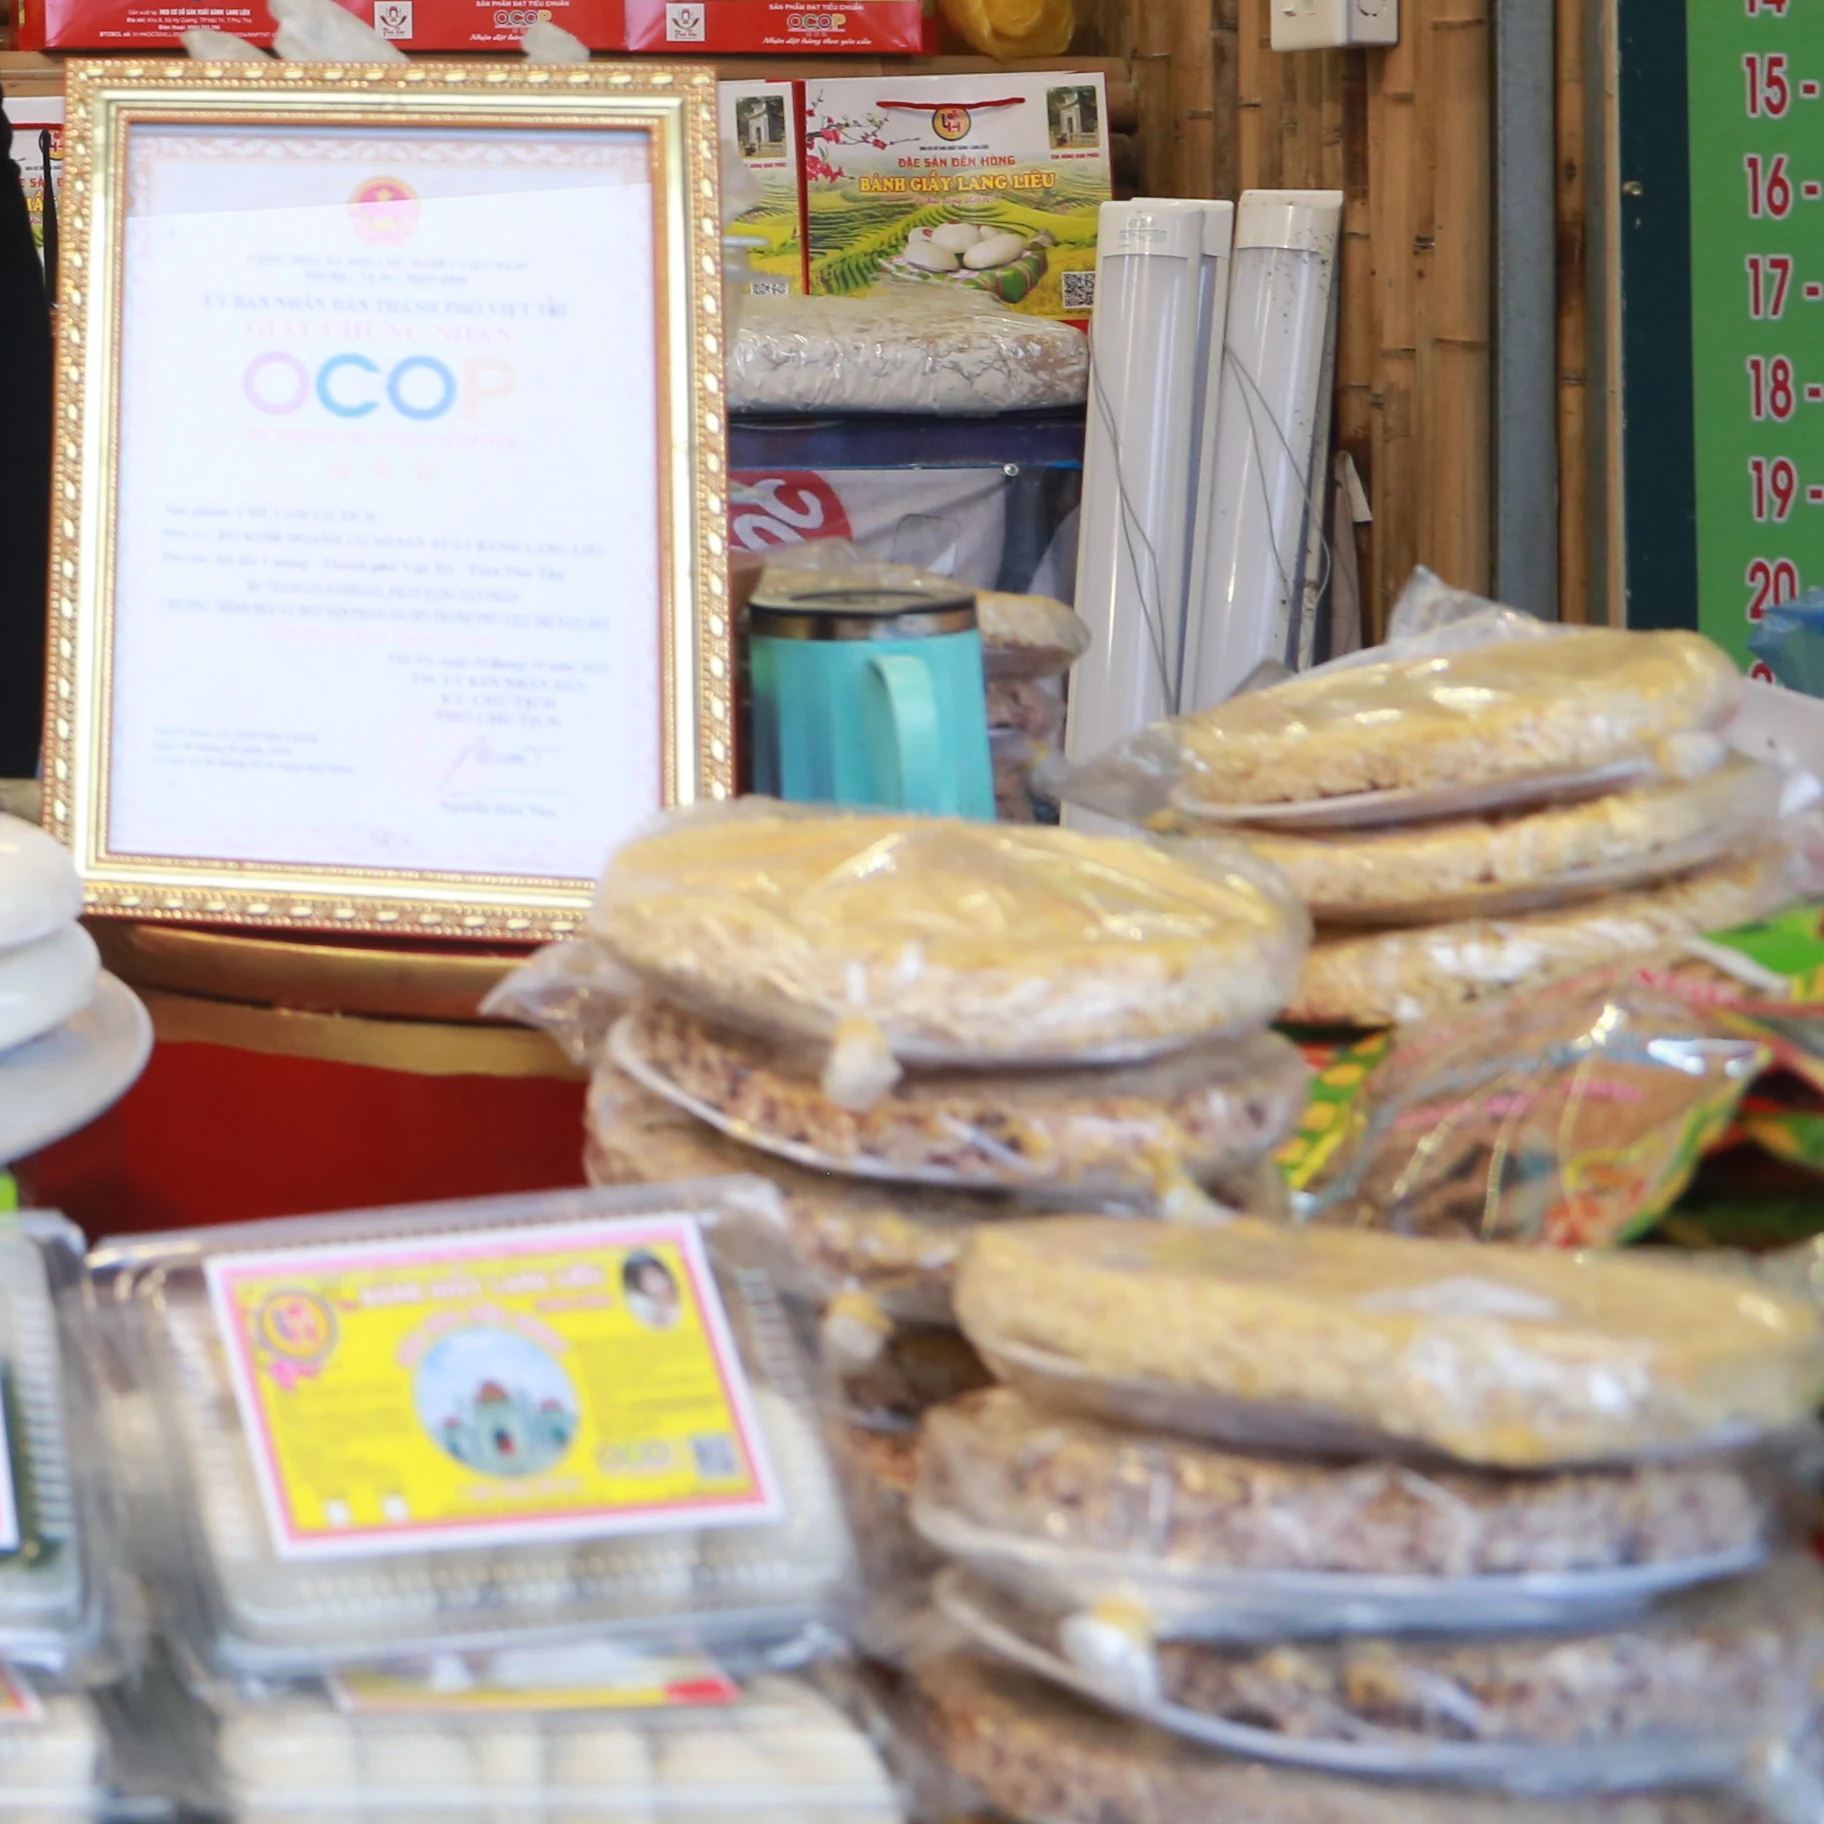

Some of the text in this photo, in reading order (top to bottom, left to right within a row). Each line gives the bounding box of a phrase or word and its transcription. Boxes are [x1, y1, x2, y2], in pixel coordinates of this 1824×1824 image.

[494, 9, 552, 26] OCOP
[787, 13, 846, 28] OCOP
[1745, 55, 1789, 116] 15
[860, 170, 1055, 193] BÁNH GIẦY LANG LIÊU
[1747, 156, 1791, 217] 16
[1748, 257, 1792, 316] 17
[242, 349, 519, 422] OCOP
[1750, 358, 1794, 419] 18
[1751, 459, 1795, 519] 19
[1748, 560, 1797, 621] 20
